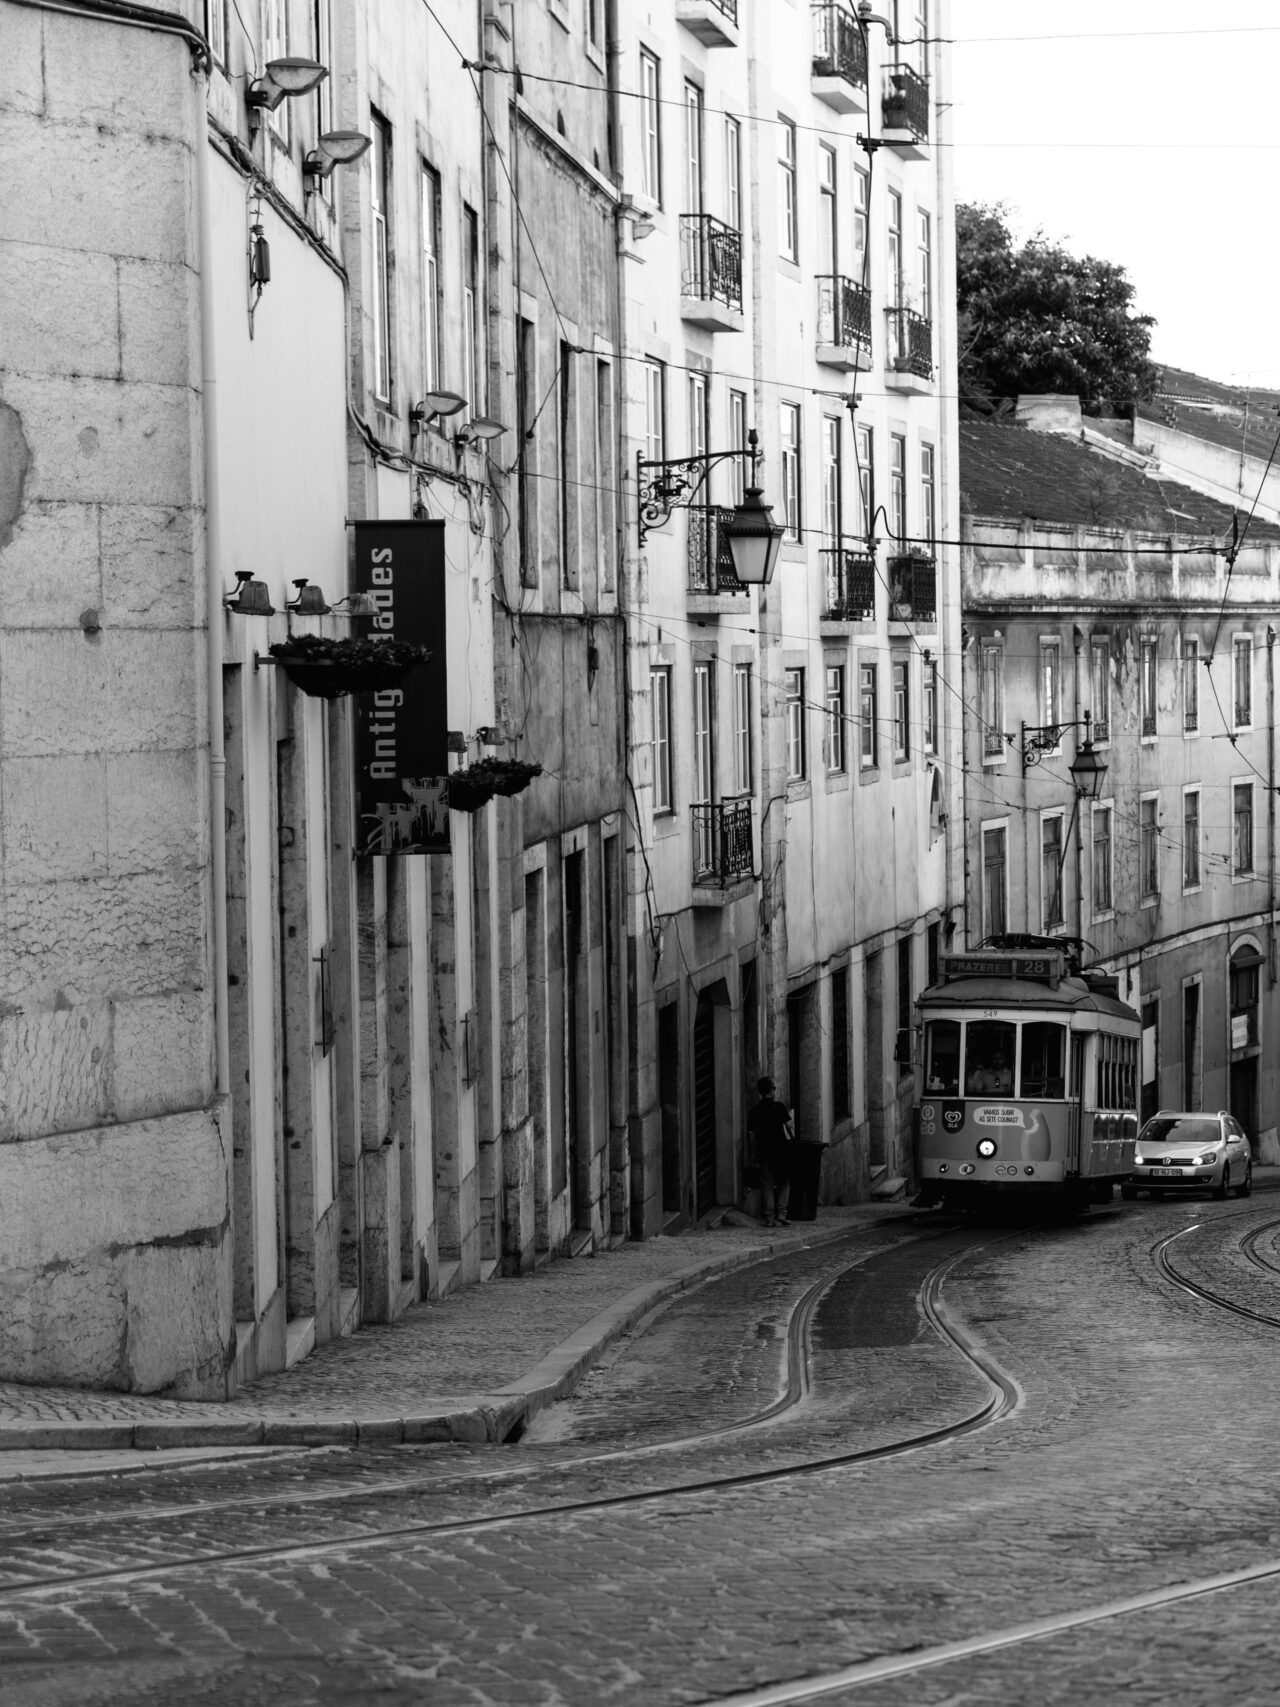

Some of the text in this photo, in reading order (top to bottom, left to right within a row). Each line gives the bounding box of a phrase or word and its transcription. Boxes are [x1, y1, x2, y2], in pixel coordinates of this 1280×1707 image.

[367, 548, 403, 780] Antigades
[1024, 961, 1045, 974] 28
[983, 1010, 998, 1018] 549
